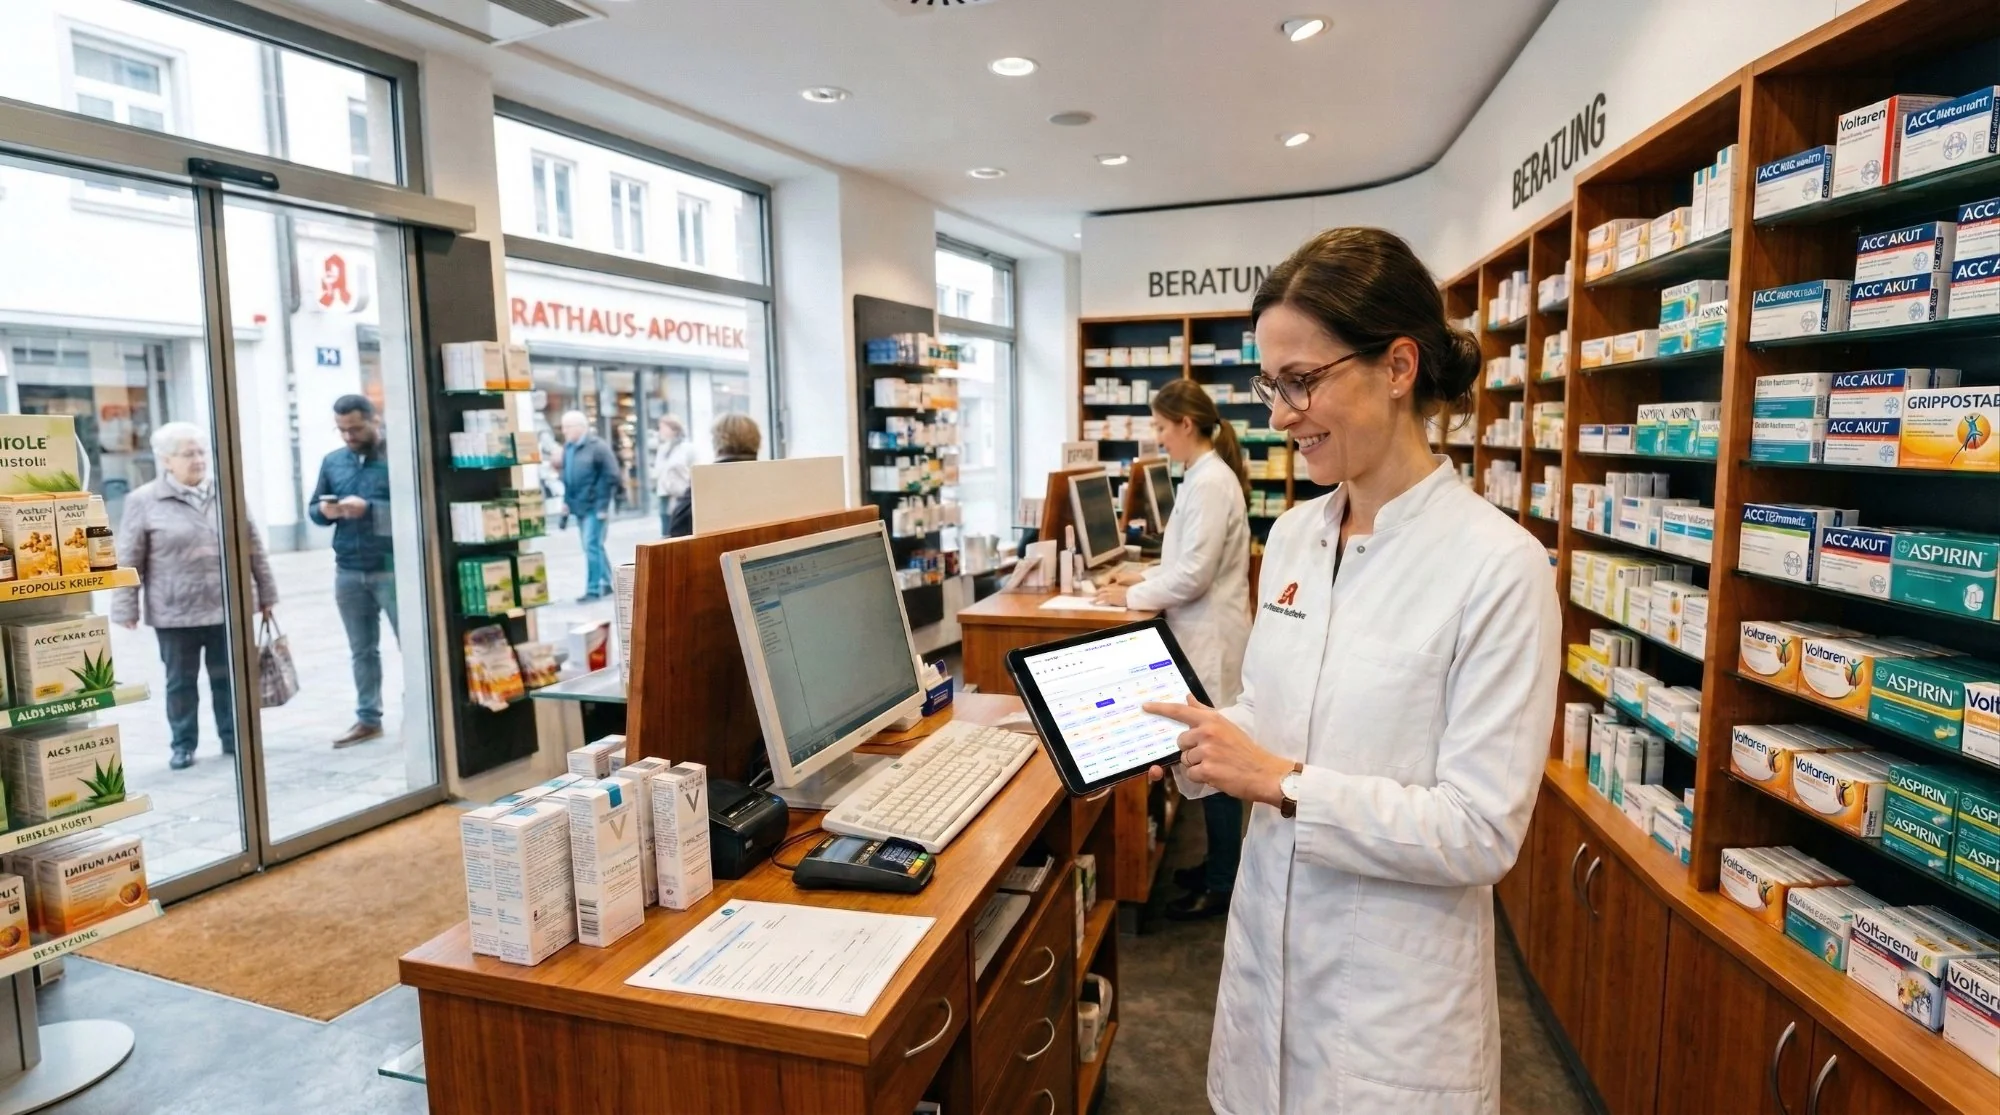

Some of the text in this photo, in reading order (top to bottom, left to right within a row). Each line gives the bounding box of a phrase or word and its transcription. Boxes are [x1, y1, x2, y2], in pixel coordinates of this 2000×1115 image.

[1840, 108, 1886, 132] Voltaren
[1907, 109, 1936, 131] ACC
[1512, 92, 1606, 210] BERATUNG
[1759, 163, 1780, 180] ACC
[1961, 202, 1996, 222] ACC
[1861, 228, 1924, 251] ACC AKUT
[1956, 260, 1989, 280] ACC
[1755, 290, 1777, 304] ACC
[1855, 278, 1919, 299] ACC AKUT
[510, 297, 745, 349] RATHAUS-APOTHEK
[1835, 372, 1895, 387] ACC AKUT
[1907, 393, 2000, 410] GRIPPOSTAB
[1830, 421, 1890, 434] ACC AKUT
[1744, 508, 1764, 521] ACC
[1824, 532, 1886, 552] ACC AKUT
[1908, 543, 1983, 568] ASPIRIN
[12, 581, 66, 595] PEOPOLIS
[1805, 642, 1846, 665] Voltaren
[1733, 728, 1767, 754] Voltaren
[1795, 757, 1835, 785] Voltaren
[1898, 777, 1947, 805] ASPIRIN
[1894, 818, 1941, 848] ASPIRIN
[1722, 852, 1758, 884] Voltaren
[1968, 848, 2000, 872] ASPI
